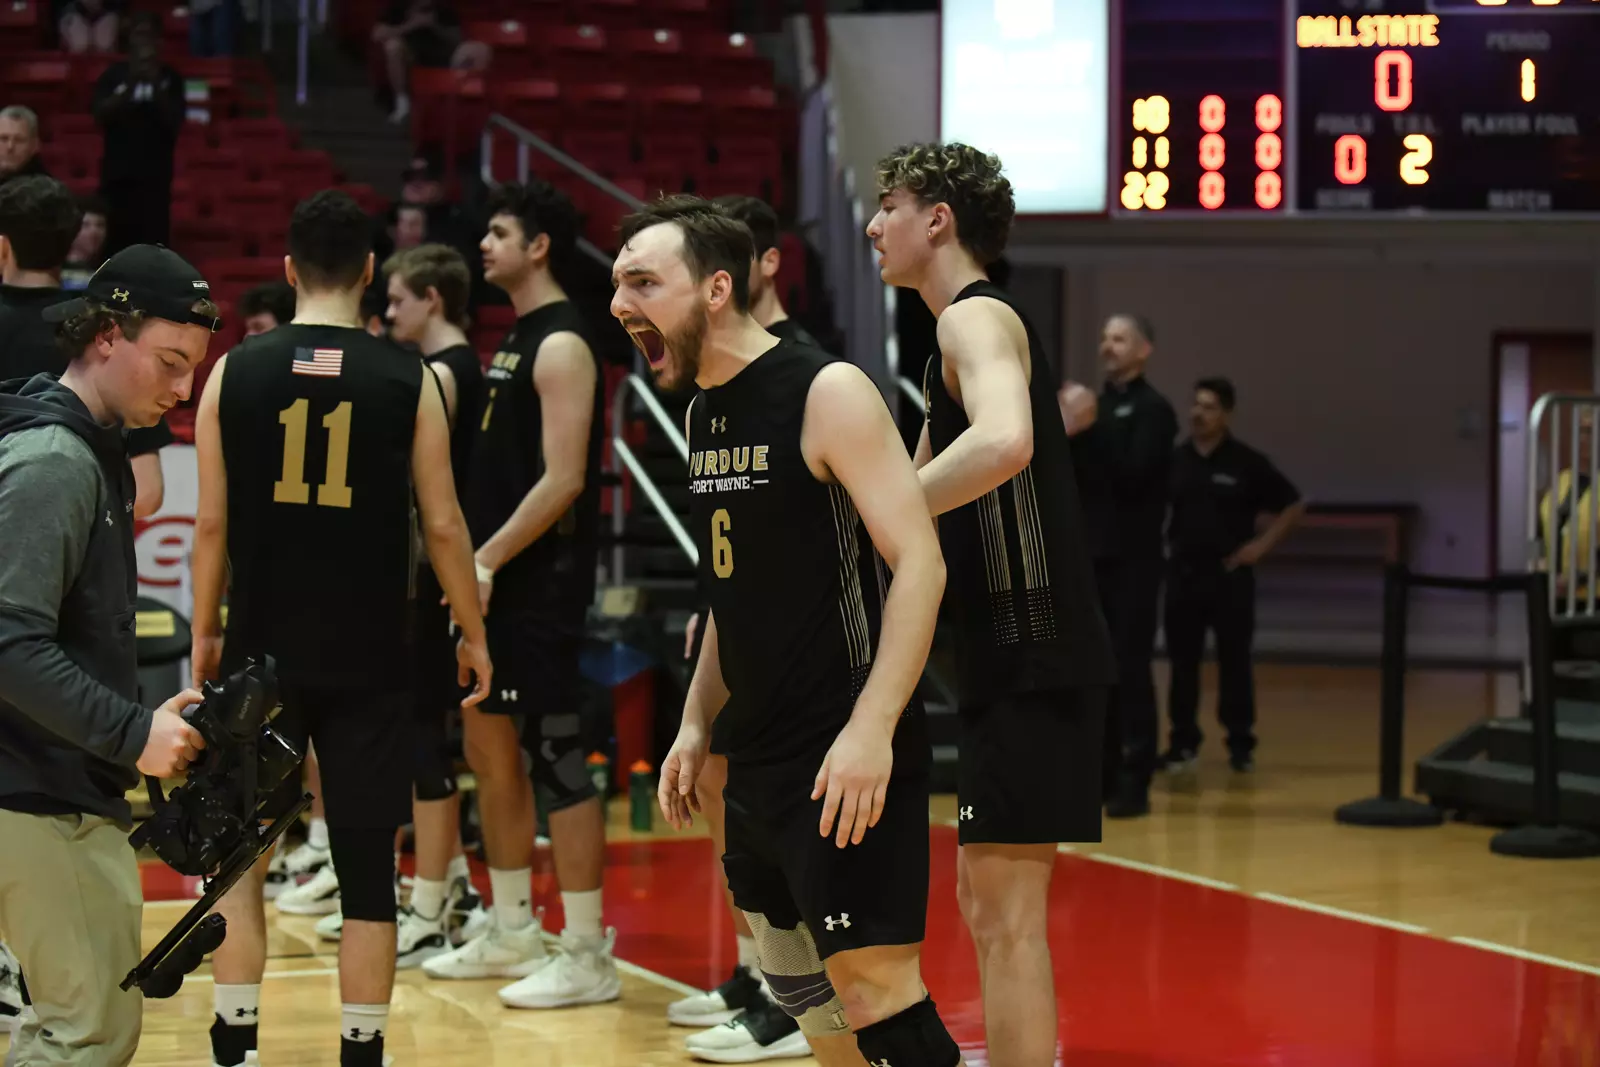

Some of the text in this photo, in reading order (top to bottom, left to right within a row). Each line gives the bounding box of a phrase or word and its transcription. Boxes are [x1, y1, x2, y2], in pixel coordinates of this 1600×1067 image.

[1357, 15, 1440, 47] STATE
[1375, 50, 1412, 110] 0
[1521, 58, 1536, 102] 1
[1199, 94, 1226, 132] 0
[1255, 94, 1282, 132] 0
[1132, 133, 1282, 171] 11 0 0
[1335, 134, 1367, 184] 0
[1400, 134, 1433, 185] 2
[1121, 171, 1282, 210] 22 0 0
[273, 398, 352, 508] 11
[689, 445, 769, 478] PURDUE
[715, 476, 750, 492] WAYNE
[711, 508, 734, 578] 6
